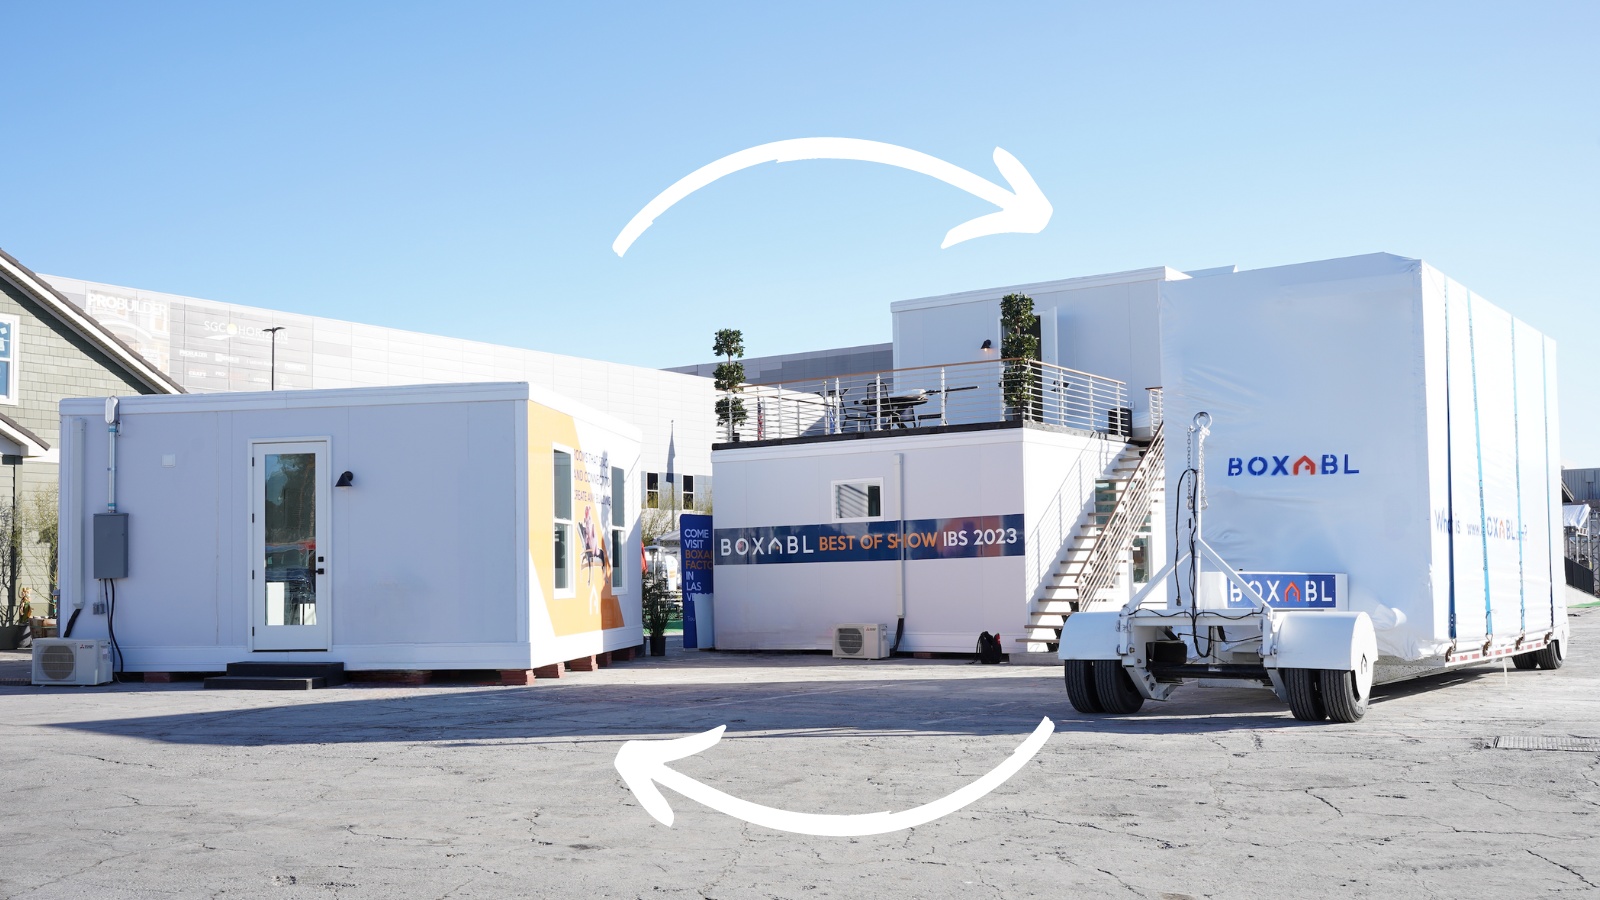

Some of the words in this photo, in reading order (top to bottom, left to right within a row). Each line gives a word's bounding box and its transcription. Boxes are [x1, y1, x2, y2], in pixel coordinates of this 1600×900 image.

[87, 293, 166, 316] PROBUILDER
[204, 320, 226, 333] SGC
[1228, 454, 1359, 476] BOXABL
[1434, 507, 1453, 535] Wh
[684, 528, 709, 538] COME
[684, 539, 704, 549] VISIT
[721, 535, 813, 557] BOXABL
[820, 535, 854, 552] BEST
[860, 533, 883, 550] OF
[887, 531, 938, 549] SHOW
[943, 530, 968, 546] IBS
[974, 528, 1018, 545] 2023
[685, 549, 712, 559] BOXA
[685, 560, 712, 570] FACTO
[686, 571, 694, 580] IN
[686, 582, 702, 591] LAS
